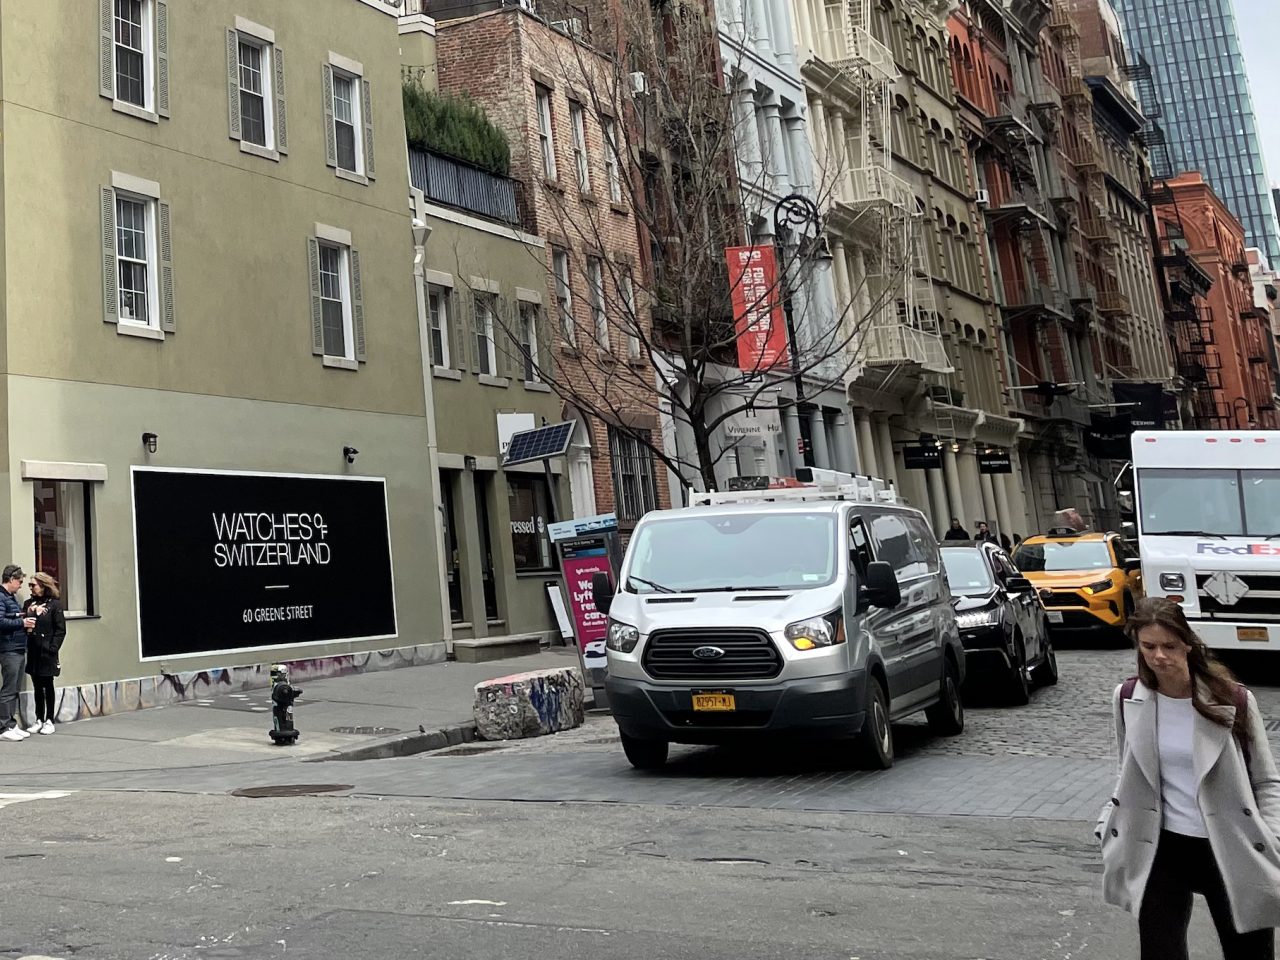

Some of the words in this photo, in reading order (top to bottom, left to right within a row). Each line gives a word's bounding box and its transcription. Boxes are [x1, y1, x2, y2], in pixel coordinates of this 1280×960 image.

[212, 512, 313, 541] WATCHES
[313, 513, 328, 540] OF
[510, 516, 535, 534] ressed
[214, 542, 331, 567] SWITZERLAND
[242, 609, 253, 623] 60
[254, 607, 285, 623] GREENE
[286, 605, 314, 620] STREET
